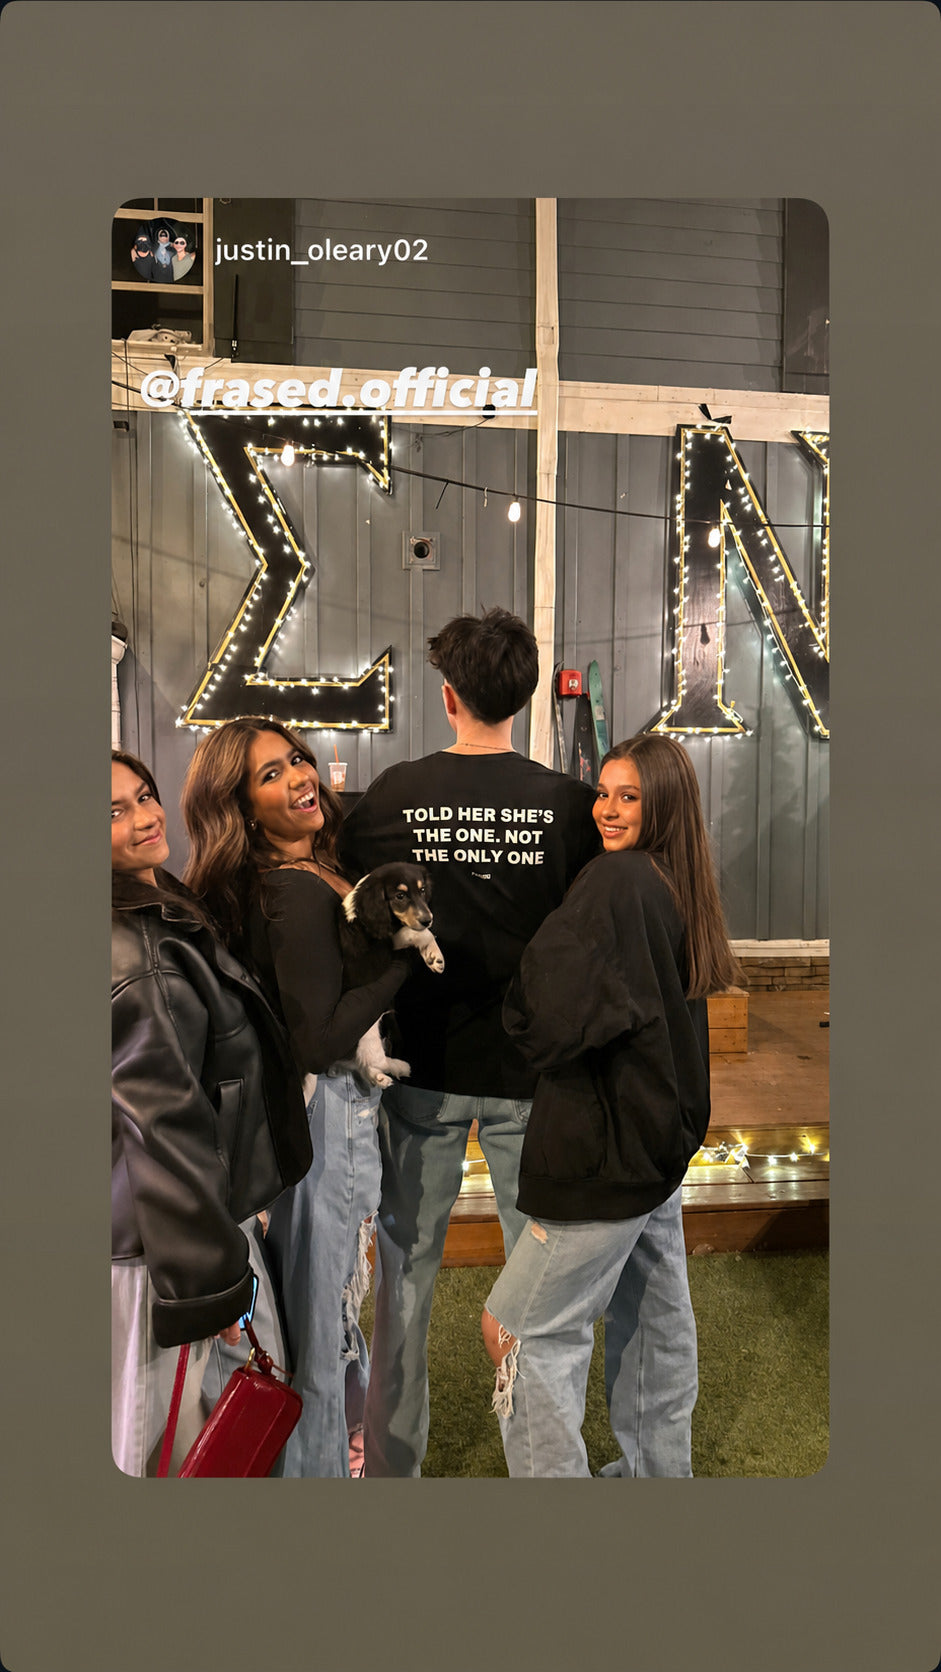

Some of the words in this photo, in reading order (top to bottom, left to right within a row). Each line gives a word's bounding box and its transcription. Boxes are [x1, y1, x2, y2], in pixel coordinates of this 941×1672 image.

[402, 806, 454, 823] TOLD
[457, 807, 496, 822] HER
[500, 808, 554, 824] SHE’S
[412, 828, 452, 843] THE
[455, 828, 501, 843] ONE.
[504, 829, 544, 845] NOT
[411, 849, 450, 862] THE
[453, 849, 504, 863] ONLY
[507, 850, 545, 865] ONE
